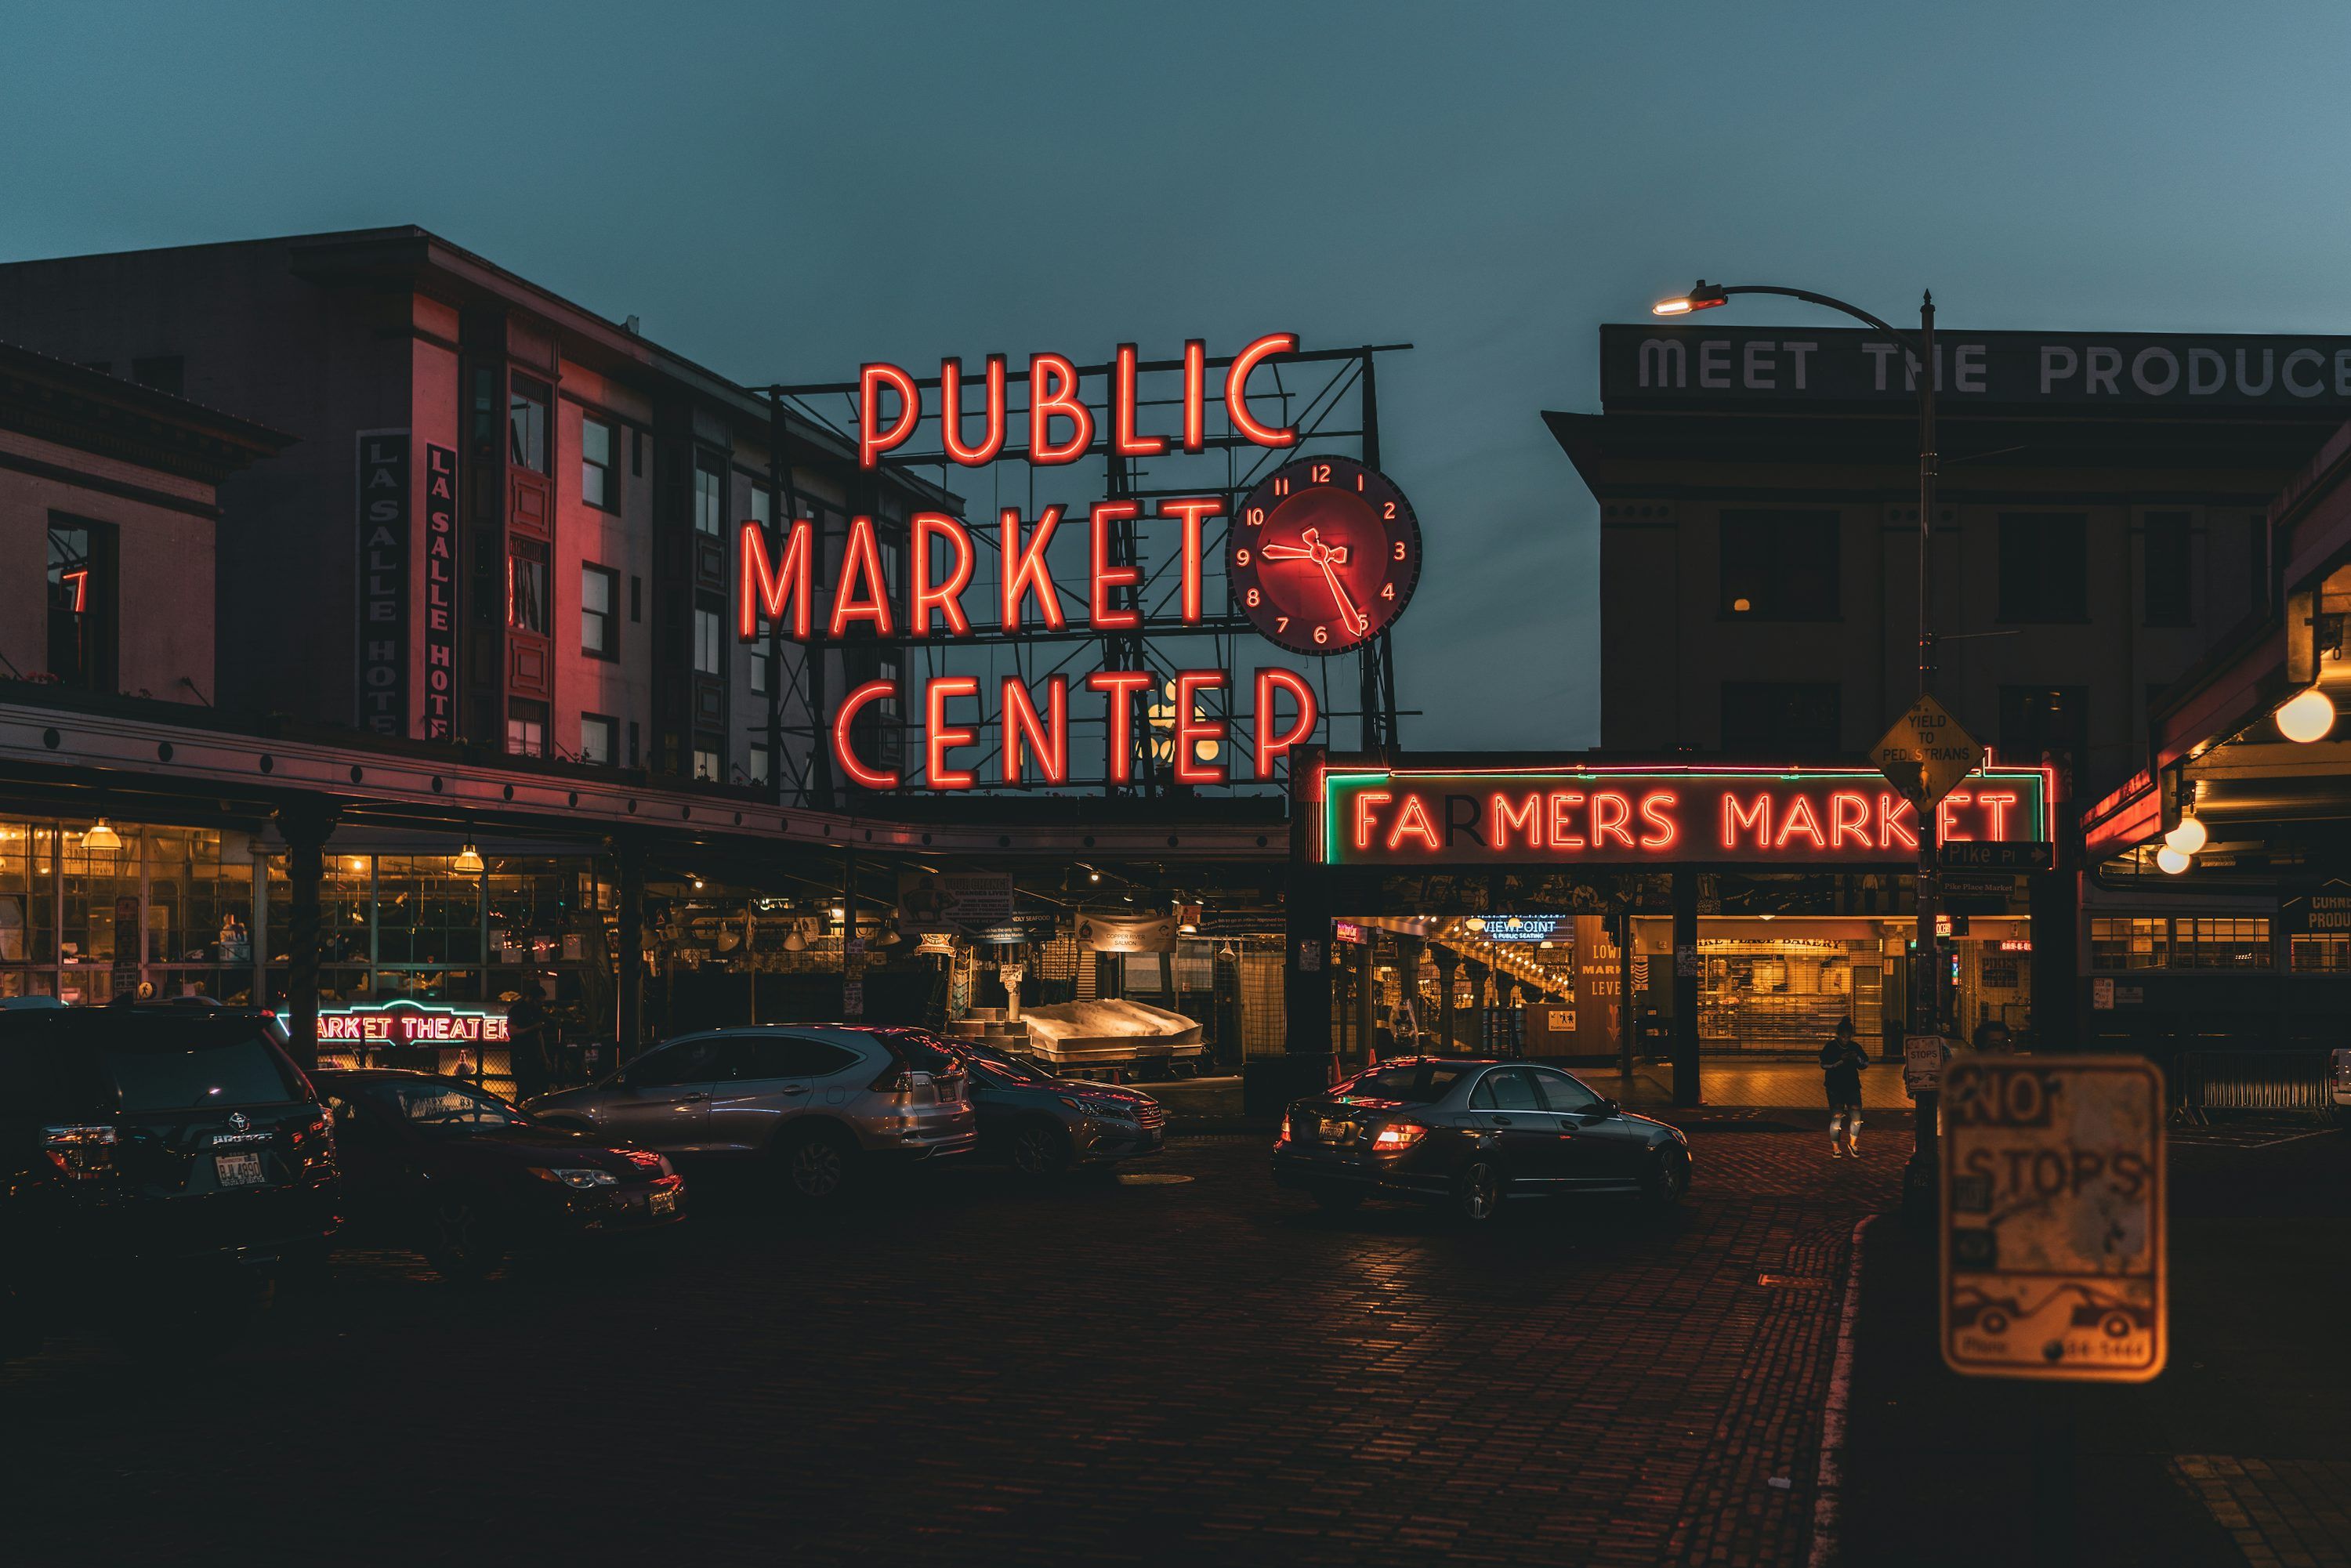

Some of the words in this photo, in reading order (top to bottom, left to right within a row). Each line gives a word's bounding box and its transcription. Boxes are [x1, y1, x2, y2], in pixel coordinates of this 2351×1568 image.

[1639, 339, 1819, 389] MEET
[1862, 342, 1987, 393] THE
[859, 332, 1300, 470] PUBLIC
[368, 444, 399, 488] LA
[431, 450, 450, 499] LA
[1312, 464, 1331, 483] 12
[1275, 477, 1289, 496] 11
[1247, 508, 1264, 526] 10
[1383, 502, 1396, 520] 2
[1236, 549, 1250, 567] 9
[1393, 541, 1406, 560] 3
[368, 500, 399, 621] SALLE
[431, 512, 450, 631] SALLE
[738, 497, 1230, 644] MARKET
[1247, 588, 1260, 607] 8
[1381, 582, 1396, 601] 4
[1276, 617, 1289, 633] 7
[1313, 625, 1328, 644] 6
[366, 640, 397, 737] HOTE
[429, 644, 450, 738] HOTE
[1908, 715, 1947, 728] YIELD
[1918, 732, 1933, 744] TO
[1883, 748, 1969, 761] PEDSTRIANS
[1357, 793, 1675, 848] FARMERS
[1724, 793, 2017, 848] MARKET
[1949, 845, 1991, 863] Pike
[944, 878, 970, 890] YOUR
[1483, 920, 1556, 933] VIEWPOINT
[317, 1017, 393, 1040] ARKET
[401, 1017, 510, 1041] THEATER
[1911, 1050, 1938, 1059] STOPS
[1962, 1070, 2039, 1123] NO
[1966, 1147, 2147, 1200] STOPS
